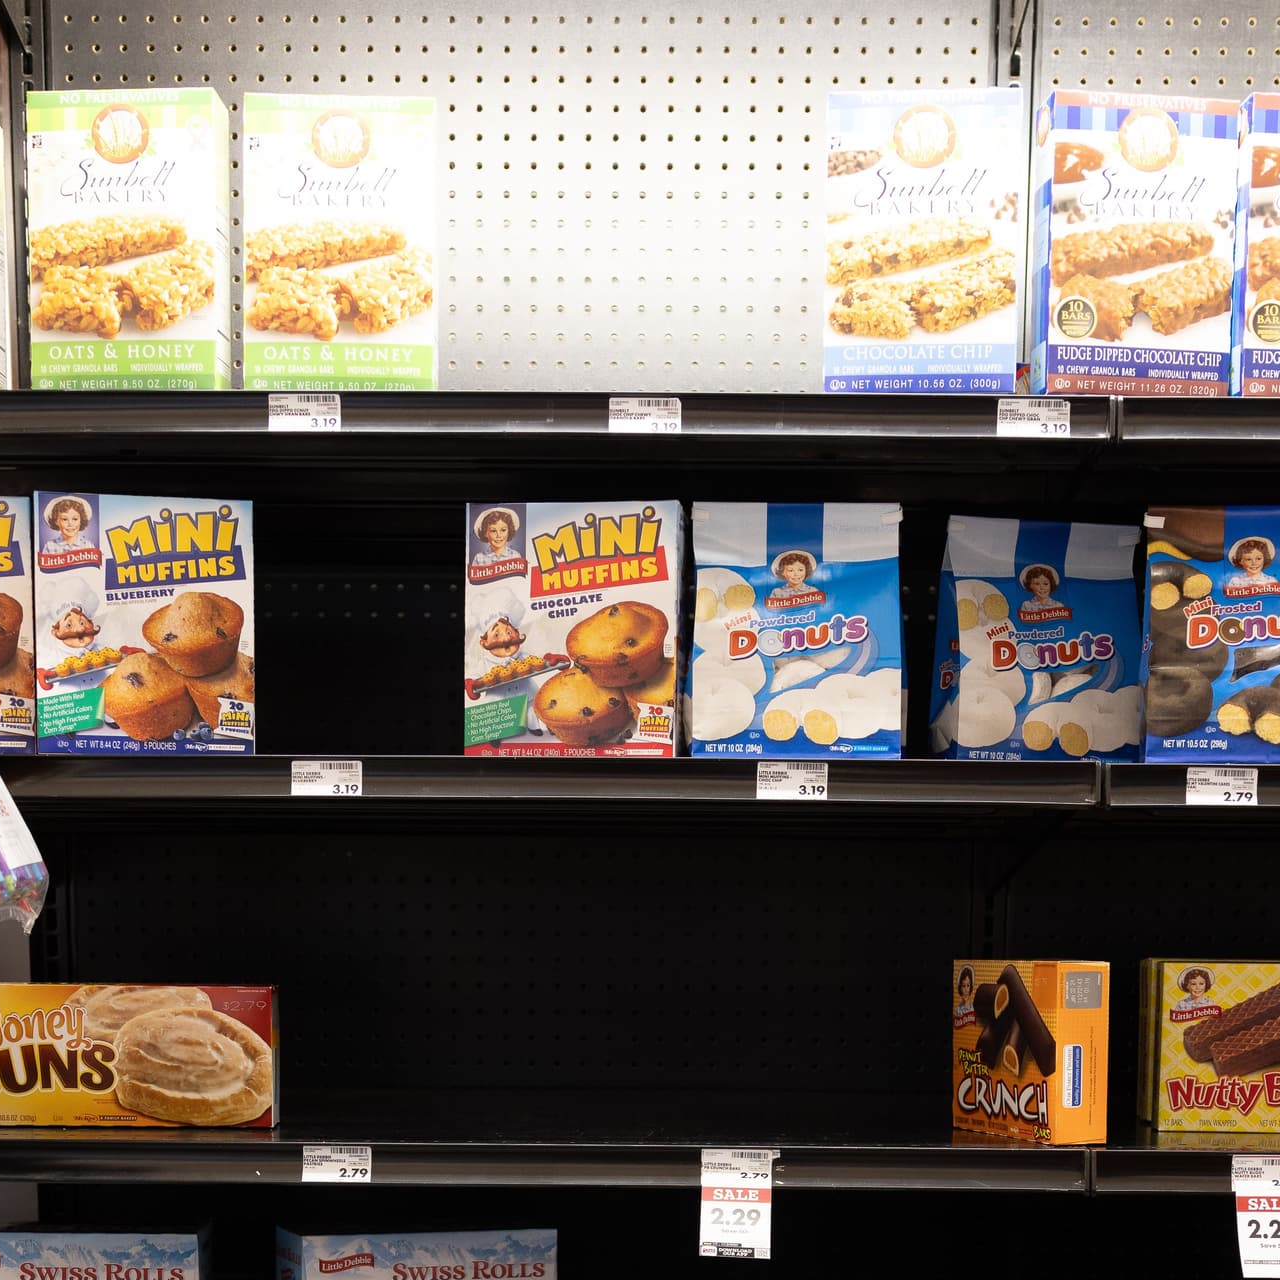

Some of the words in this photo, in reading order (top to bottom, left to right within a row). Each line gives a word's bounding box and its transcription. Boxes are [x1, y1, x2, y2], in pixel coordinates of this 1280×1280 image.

[49, 345, 93, 360] OATS
[100, 344, 117, 359] &
[126, 344, 195, 358] HONEY
[844, 345, 944, 361] CHOCOLATE
[951, 345, 992, 360] CHIP
[850, 380, 871, 388] NET
[874, 379, 914, 388] WEIGHT
[917, 379, 943, 388] 10.56
[40, 554, 64, 567] Little
[66, 552, 99, 564] Debbie
[116, 556, 236, 584] MUFFINS
[542, 558, 658, 590] MUFFINS
[106, 588, 175, 601] BLUEBERRY
[531, 594, 603, 610] CHOCOLATE
[548, 606, 578, 618] CHIP
[1211, 602, 1262, 616] Frosted
[750, 611, 815, 629] Powdered
[728, 614, 868, 658] Donuts
[332, 784, 358, 794] 3.19
[798, 785, 825, 796] 3.19
[1223, 791, 1253, 803] 2.79
[957, 1077, 1049, 1124] CRUNCH
[339, 1168, 368, 1179] 2.79
